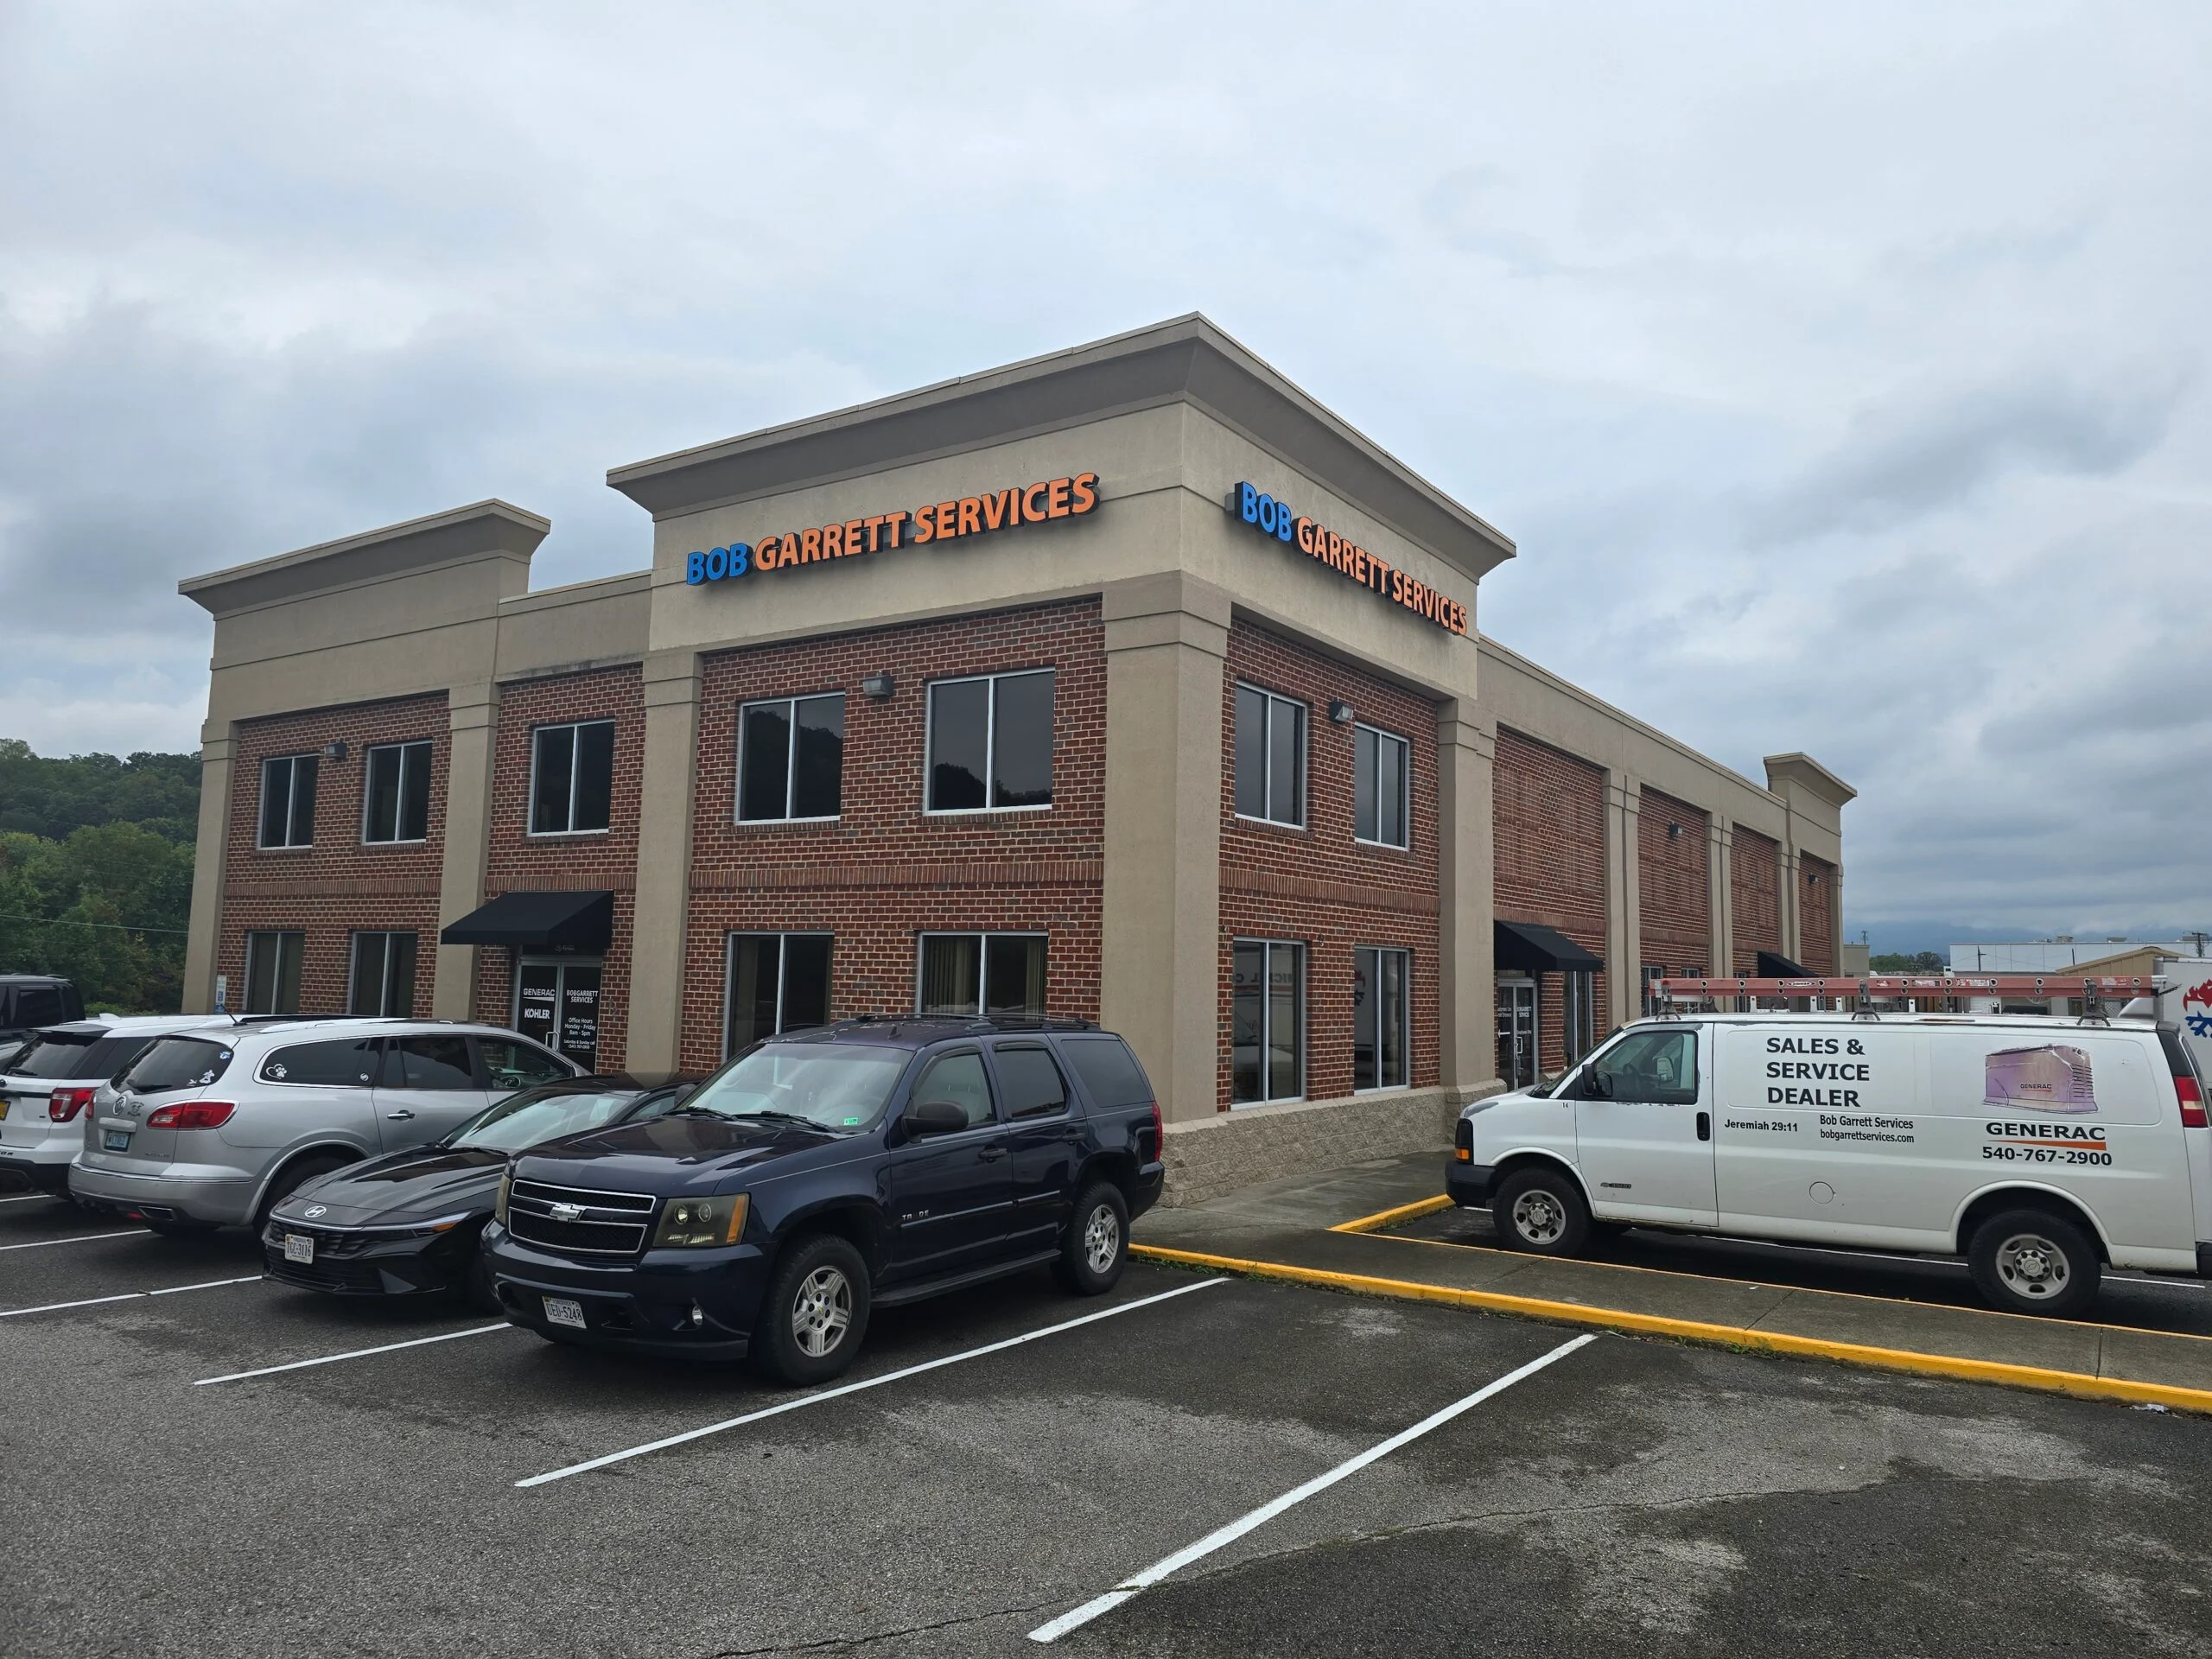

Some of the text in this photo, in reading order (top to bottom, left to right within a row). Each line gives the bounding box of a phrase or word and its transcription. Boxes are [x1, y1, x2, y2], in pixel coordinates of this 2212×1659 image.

[686, 472, 1098, 585] BOB GARRETT SERVICES
[1238, 480, 1467, 636] BOB GARRETT SERVICES
[523, 988, 556, 996] GENERAC
[524, 1007, 550, 1020] KOHLER
[1766, 1037, 1866, 1055] SALES &
[1766, 1061, 1870, 1081] SERVICE
[1768, 1086, 1861, 1107] DEALER
[1725, 1119, 1798, 1132] Jeremiah 29:11
[1820, 1115, 1914, 1129] Bob Garrett Services
[1820, 1129, 1915, 1143] bobgarrettservices.com
[1986, 1122, 2106, 1141] GENERAC
[1982, 1146, 2113, 1166] 540-767-2900
